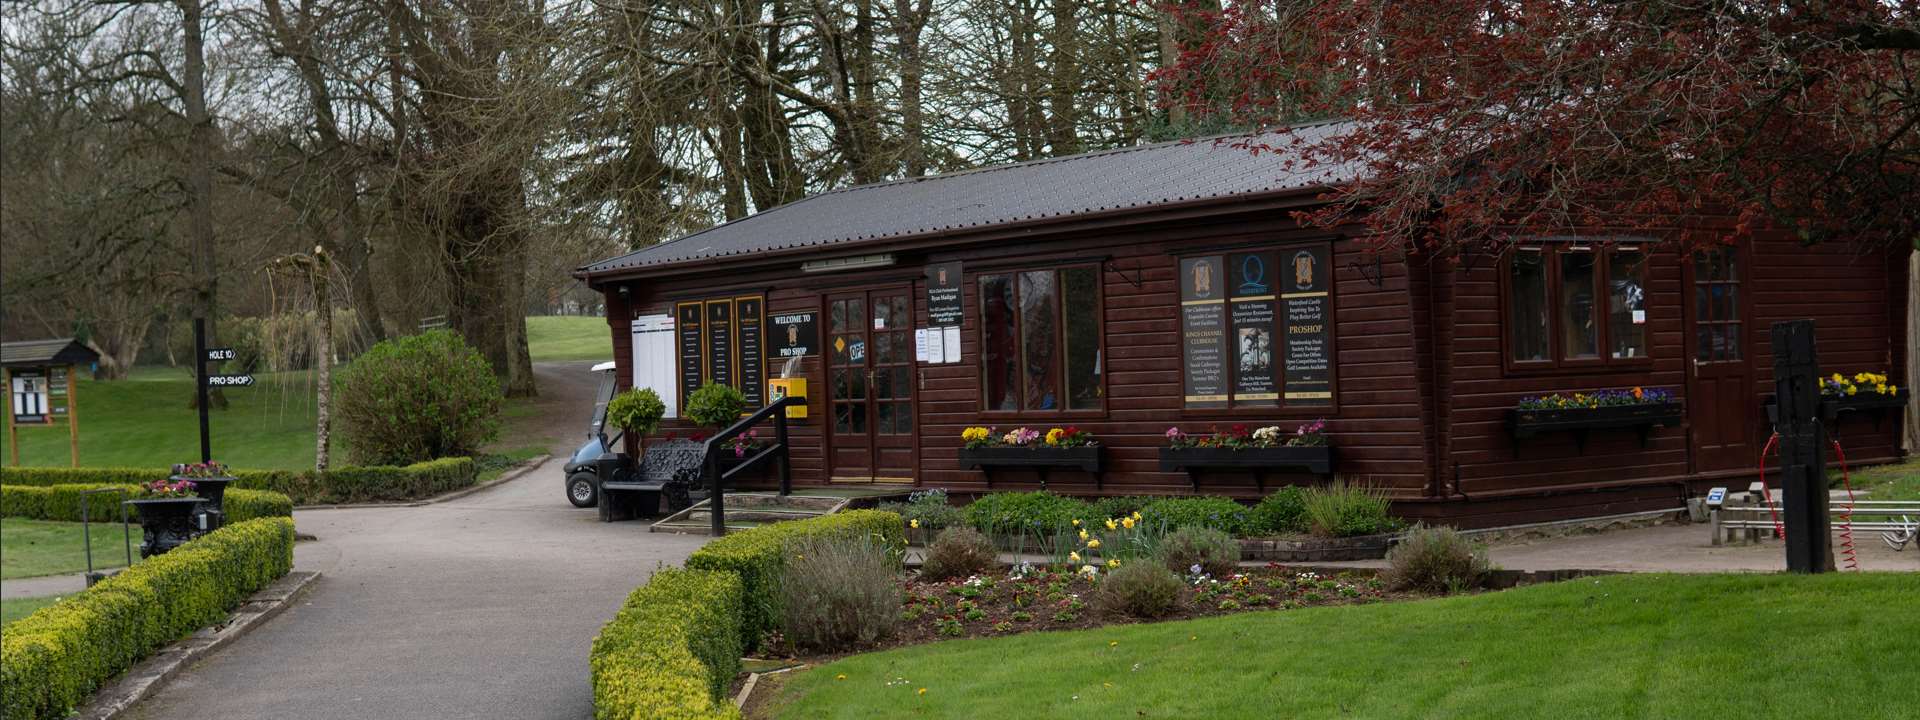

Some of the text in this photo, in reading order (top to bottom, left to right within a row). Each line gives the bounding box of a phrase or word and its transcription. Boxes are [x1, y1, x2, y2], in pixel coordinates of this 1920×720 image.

[775, 314, 811, 324] WELCOME TO
[1311, 312, 1322, 320] Golf
[1289, 324, 1323, 334] PROSHOP
[209, 350, 233, 360] HOLE 10
[780, 347, 807, 357] PRO SHOP
[849, 343, 865, 359] OPE
[209, 376, 249, 385] PRO SHOP
